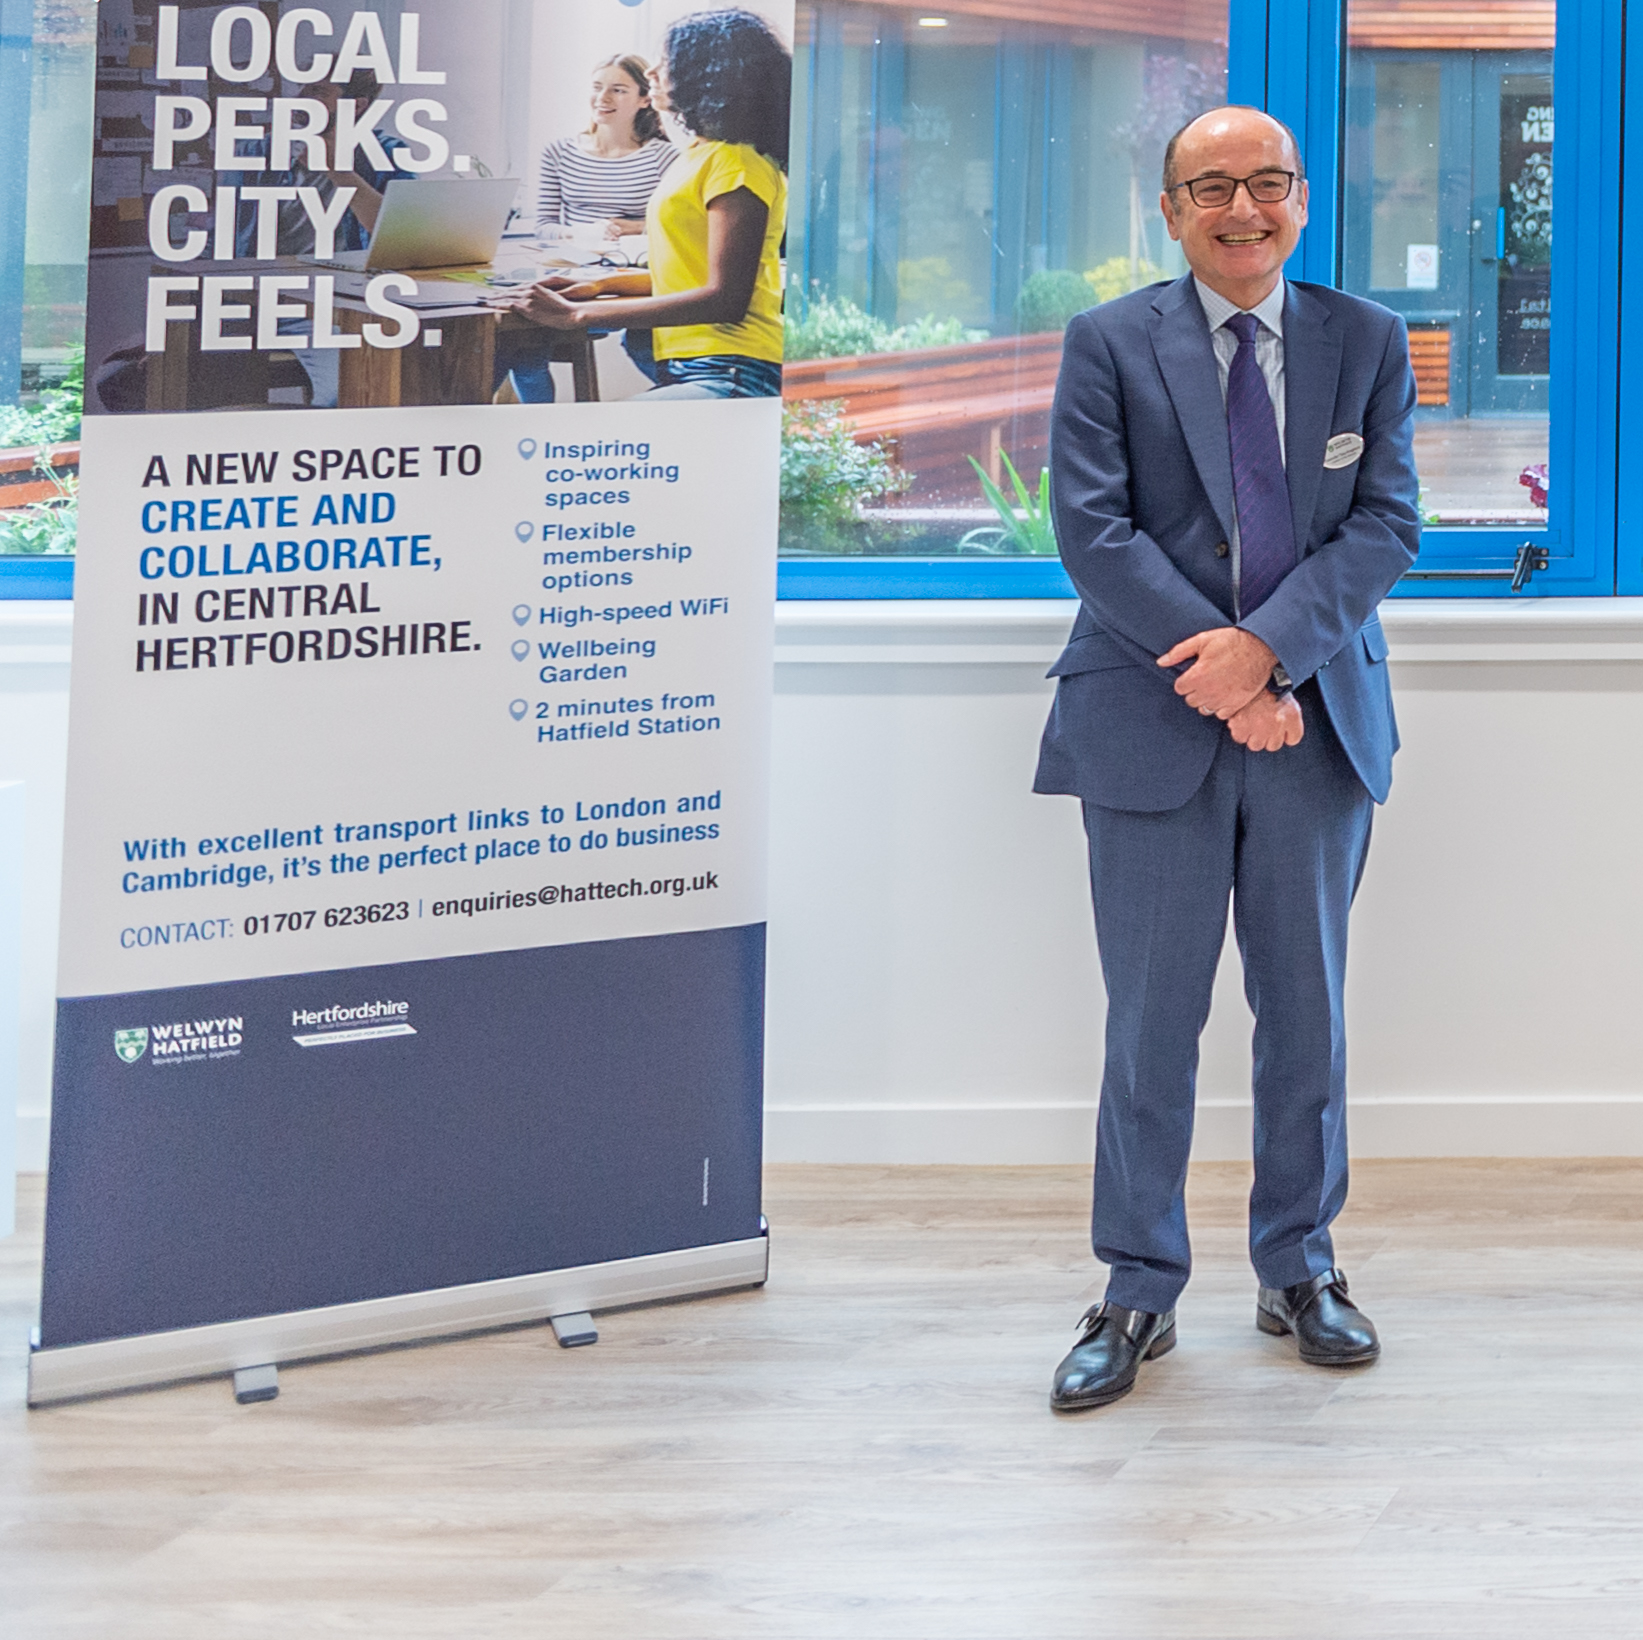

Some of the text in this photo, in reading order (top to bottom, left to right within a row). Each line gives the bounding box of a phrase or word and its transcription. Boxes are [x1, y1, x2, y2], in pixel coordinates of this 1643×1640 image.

[157, 6, 446, 84] LOCAL
[154, 96, 471, 172] PERKS.
[150, 185, 356, 261] CITY
[146, 274, 440, 351] FEELS.
[545, 440, 649, 462] Inspiring
[142, 445, 481, 487] A NEW SPACE TO
[546, 463, 678, 482] co-working
[142, 492, 395, 533] CREATE AND
[545, 491, 630, 510] spaces
[543, 522, 635, 541] Flexible
[140, 535, 441, 579] COLLABORATE,
[544, 543, 692, 565] membership
[542, 570, 633, 593] options
[139, 582, 380, 625] IN CENTRAL
[540, 598, 728, 627] High-speed WiFi
[136, 621, 480, 672] HERTFORDSHIRE.
[538, 638, 655, 659] Wellbeing
[540, 663, 626, 683] Garden
[536, 693, 714, 719] 2 minutes from
[538, 715, 720, 742] Hatfield Station
[124, 790, 720, 861] With excellent transport links to London and
[123, 863, 273, 893] Cambridge,
[330, 853, 369, 874] the
[379, 843, 467, 874] perfect
[475, 839, 540, 865] place
[549, 834, 571, 853] to
[580, 830, 608, 850] do
[617, 824, 719, 847] business
[121, 871, 718, 948] CONTACT: 01707 623623 enquiries@hattech.org.uk
[292, 1001, 409, 1026] Hertfordshire
[152, 1017, 243, 1040] WELWYN
[153, 1033, 243, 1055] HATFIELD
